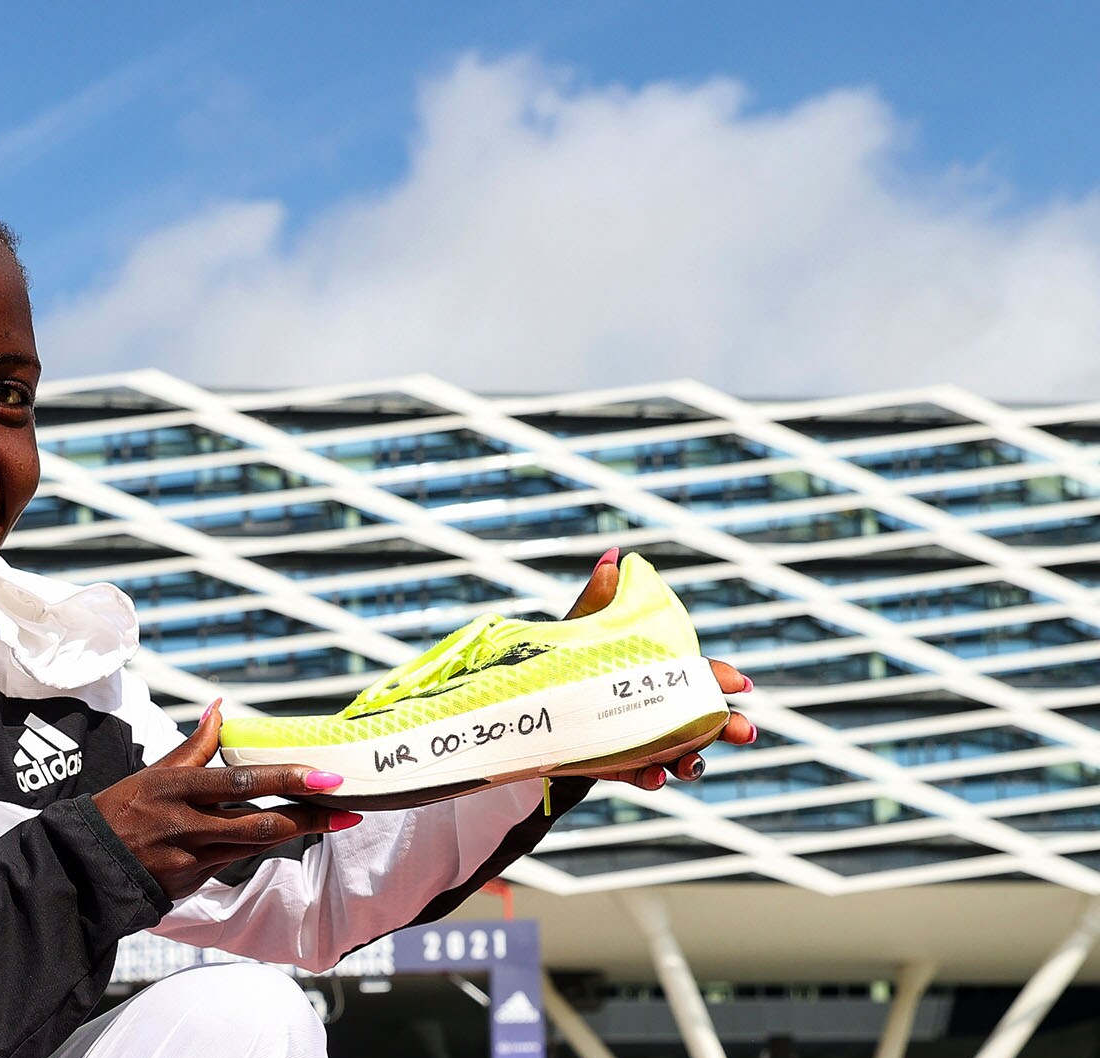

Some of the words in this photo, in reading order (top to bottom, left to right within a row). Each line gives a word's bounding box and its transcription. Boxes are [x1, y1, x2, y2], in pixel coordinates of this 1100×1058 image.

[612, 669, 689, 699] 12.9.21
[597, 700, 642, 720] LIGHTSTRIKE
[644, 695, 664, 707] PRO
[374, 744, 418, 773] WR
[430, 707, 552, 757] 00:30:01
[15, 749, 83, 793] adidas
[422, 929, 507, 961] 2021
